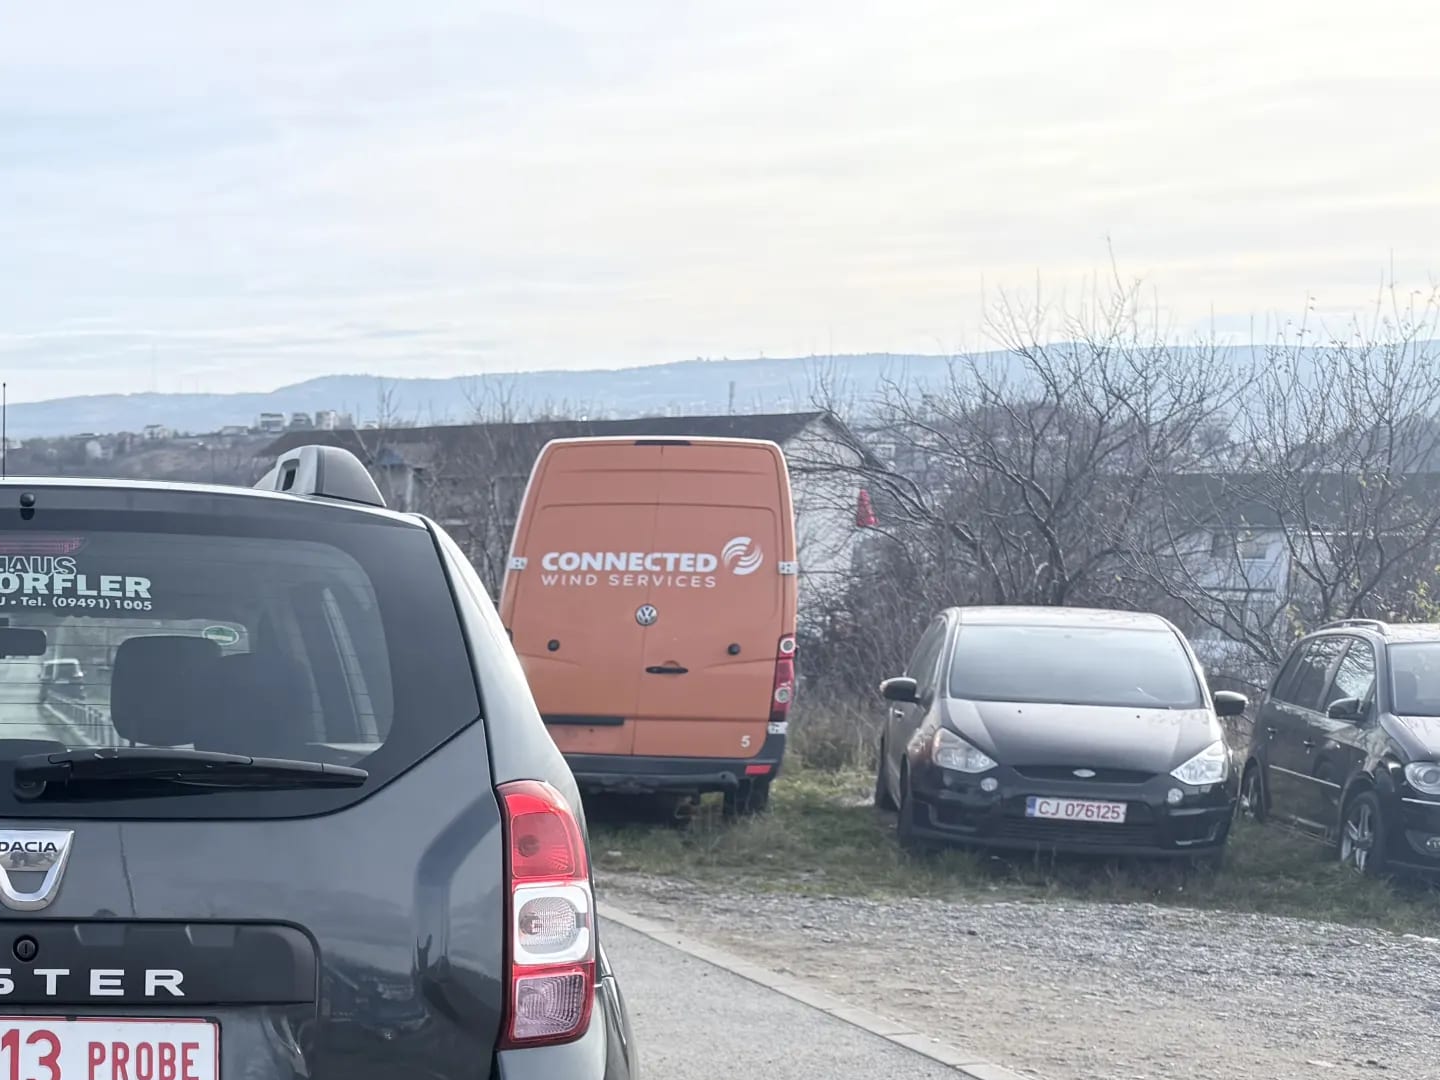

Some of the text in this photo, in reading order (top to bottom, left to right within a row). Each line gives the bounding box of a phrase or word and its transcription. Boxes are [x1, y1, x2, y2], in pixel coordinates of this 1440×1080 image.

[541, 552, 718, 572] CONNECTED
[541, 574, 717, 588] WIND SERVICES
[20, 597, 47, 607] Tel.
[52, 597, 110, 609] (09491)
[115, 600, 152, 611] 1005
[741, 735, 751, 748] 5
[1038, 801, 1060, 816] CJ
[1065, 803, 1121, 820] 076125
